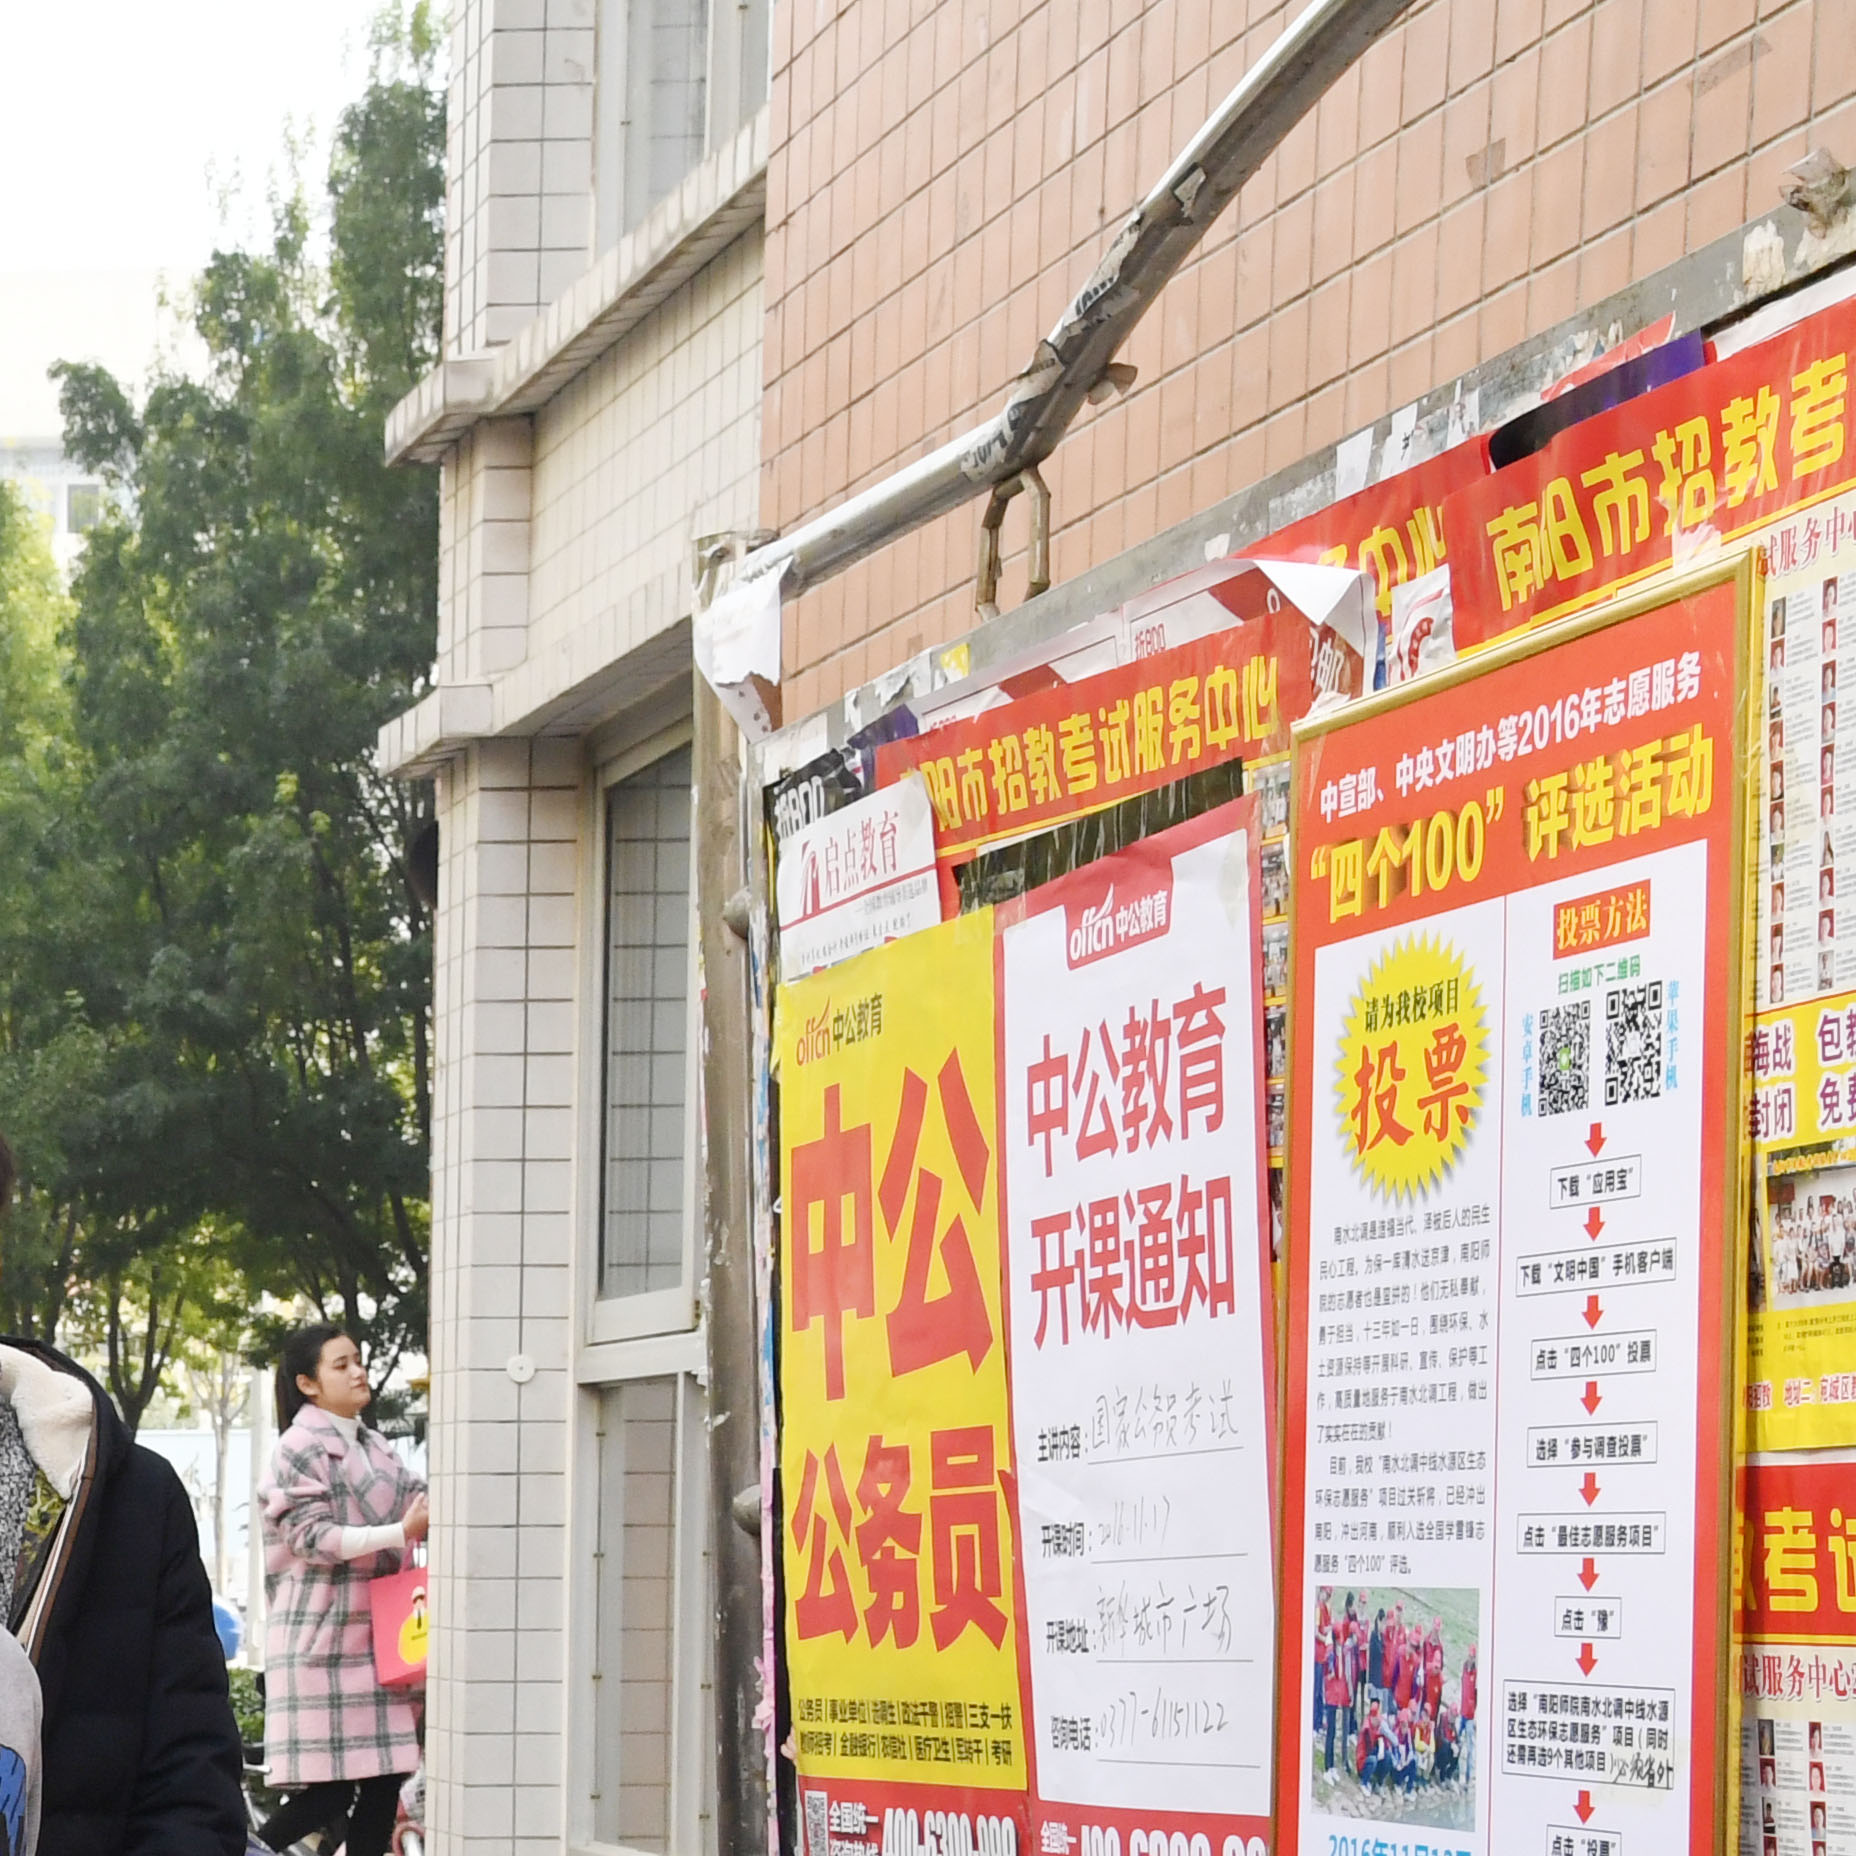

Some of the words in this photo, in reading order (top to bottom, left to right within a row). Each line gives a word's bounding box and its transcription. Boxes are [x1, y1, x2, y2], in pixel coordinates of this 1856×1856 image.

[902, 655, 1280, 832] 阳市招教考试服务中心
[1320, 651, 1701, 823] 中宣部、中央文明办等2016年志愿服务
[1525, 723, 1714, 862] 评选活动
[824, 809, 900, 897] 启点教育
[1115, 889, 1169, 946] 中公教育
[1556, 888, 1648, 951] 投票方法
[832, 991, 884, 1053] 中公教育
[1364, 976, 1460, 1034] 请为我校项目
[1557, 954, 1641, 995] 扫描如下二维码
[1025, 981, 1229, 1178] 中公教育
[1350, 1022, 1470, 1156] 投票
[790, 1047, 992, 1401] 中公
[1029, 1173, 1238, 1350] 开课通知
[795, 1424, 1010, 1654] 公务员
[1742, 1653, 1856, 1698] 试服务中心
[829, 1800, 880, 1835] 全国统一
